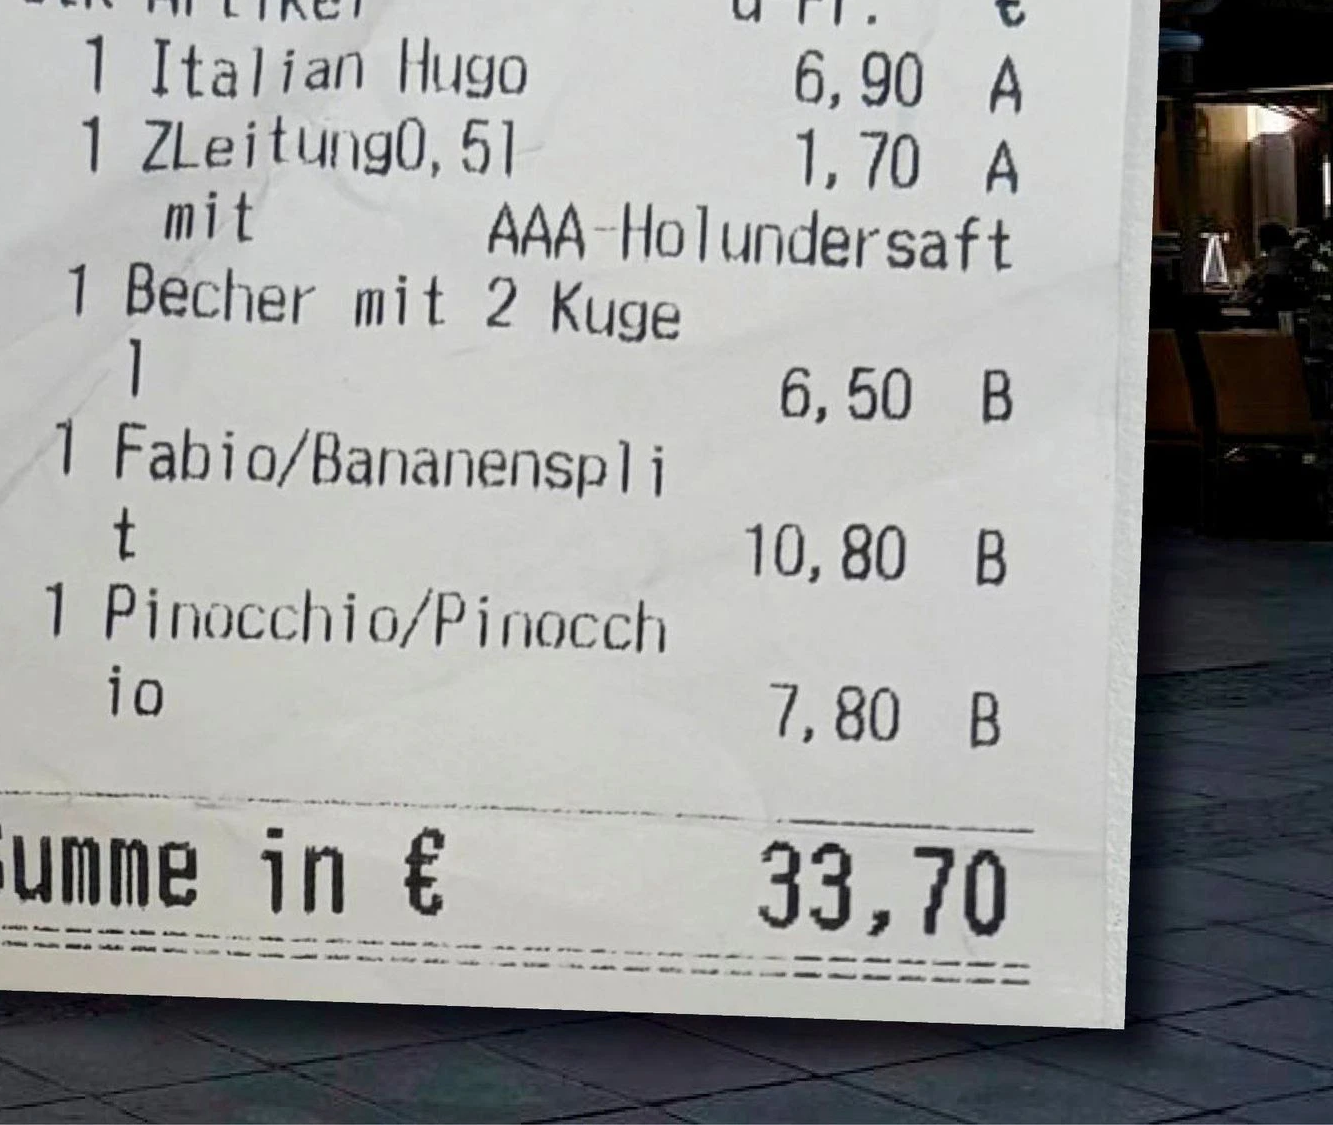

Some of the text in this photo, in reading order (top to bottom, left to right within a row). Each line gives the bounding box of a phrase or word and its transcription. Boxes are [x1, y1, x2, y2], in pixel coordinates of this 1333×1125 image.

[85, 34, 1023, 114] 1 Italian Hugo 6,90 A
[81, 116, 101, 173] 1
[795, 128, 920, 190] 1,70
[985, 140, 1020, 193] A
[164, 190, 1013, 271] mit AAA-Holundersaft
[67, 261, 682, 342] 1 Becher mit 2 Kuge
[780, 367, 913, 424] 6,50
[981, 369, 1013, 423] B
[55, 419, 666, 498] 1 Fabio/Bananenspli
[113, 507, 1007, 586] t 10,80 B
[45, 582, 667, 655] 1 Pinocchio/Pinocch
[107, 665, 1000, 748] io 7,80 B
[260, 827, 344, 914] in
[404, 827, 445, 916] €
[758, 841, 1007, 936] 33,70
